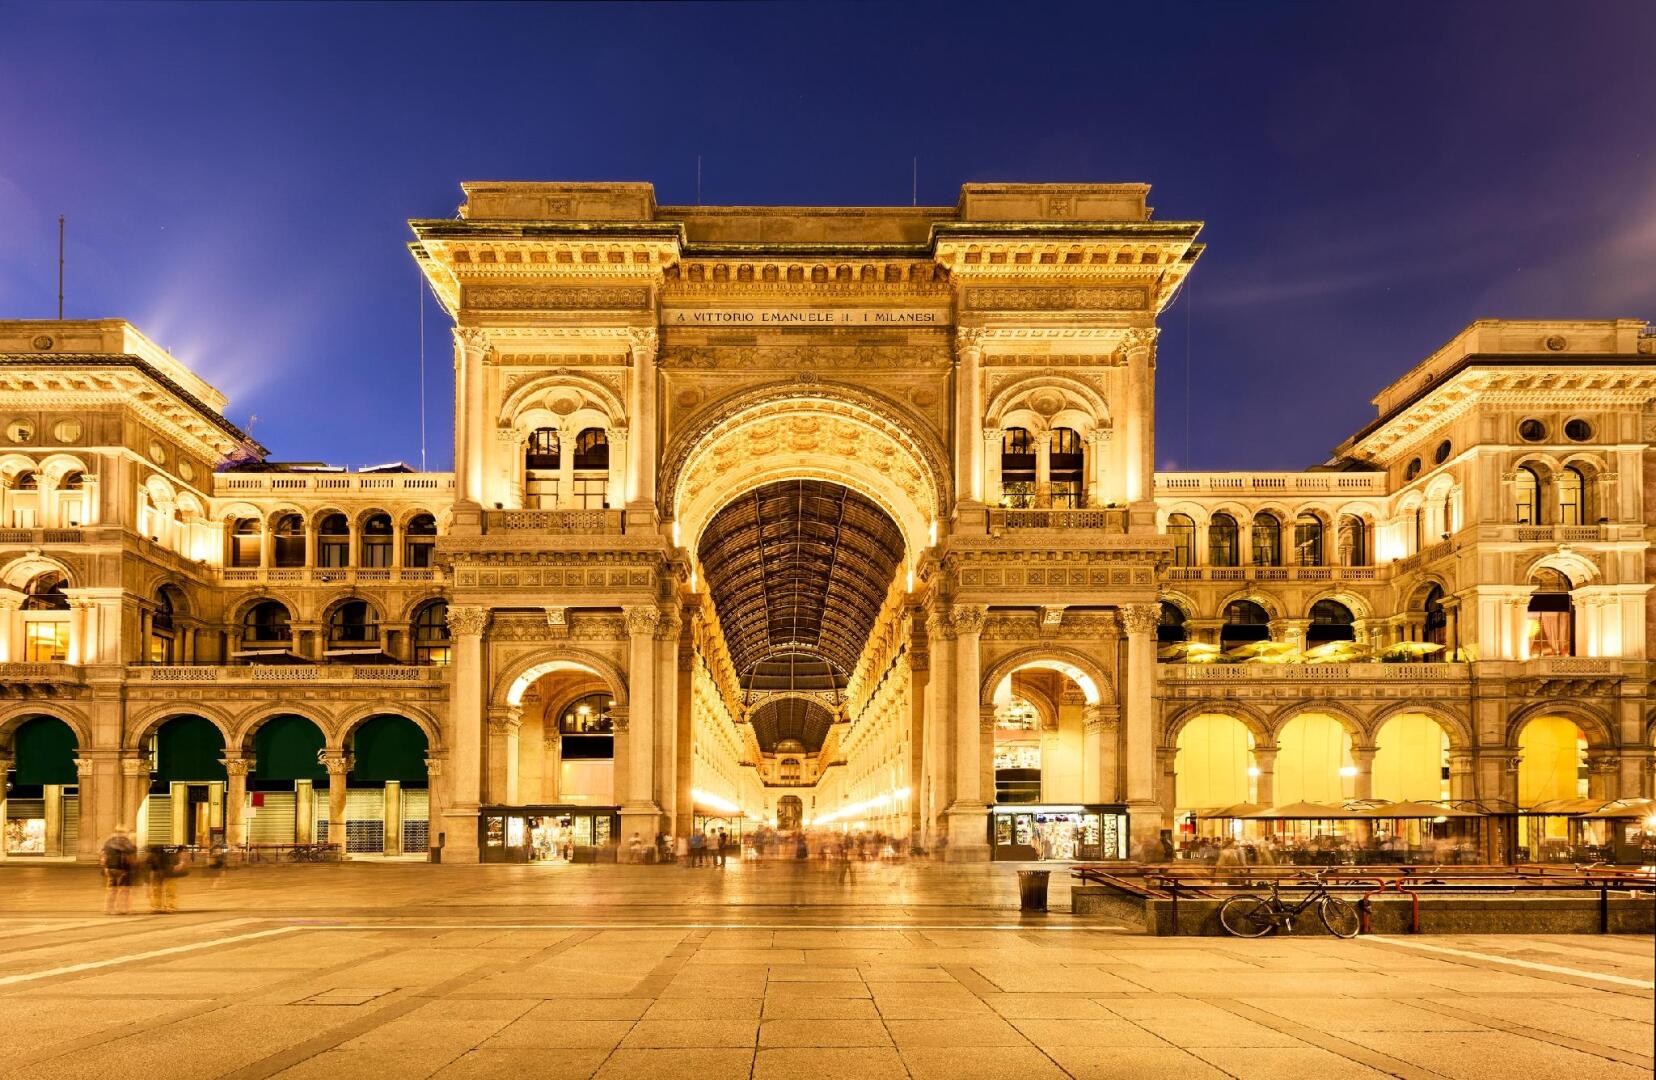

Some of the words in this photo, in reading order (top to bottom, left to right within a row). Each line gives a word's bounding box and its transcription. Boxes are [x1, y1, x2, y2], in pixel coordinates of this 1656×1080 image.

[677, 312, 685, 322] A
[694, 312, 754, 322] VITTORIO
[762, 312, 834, 322] EMANUELE
[875, 313, 935, 322] MILANESI
